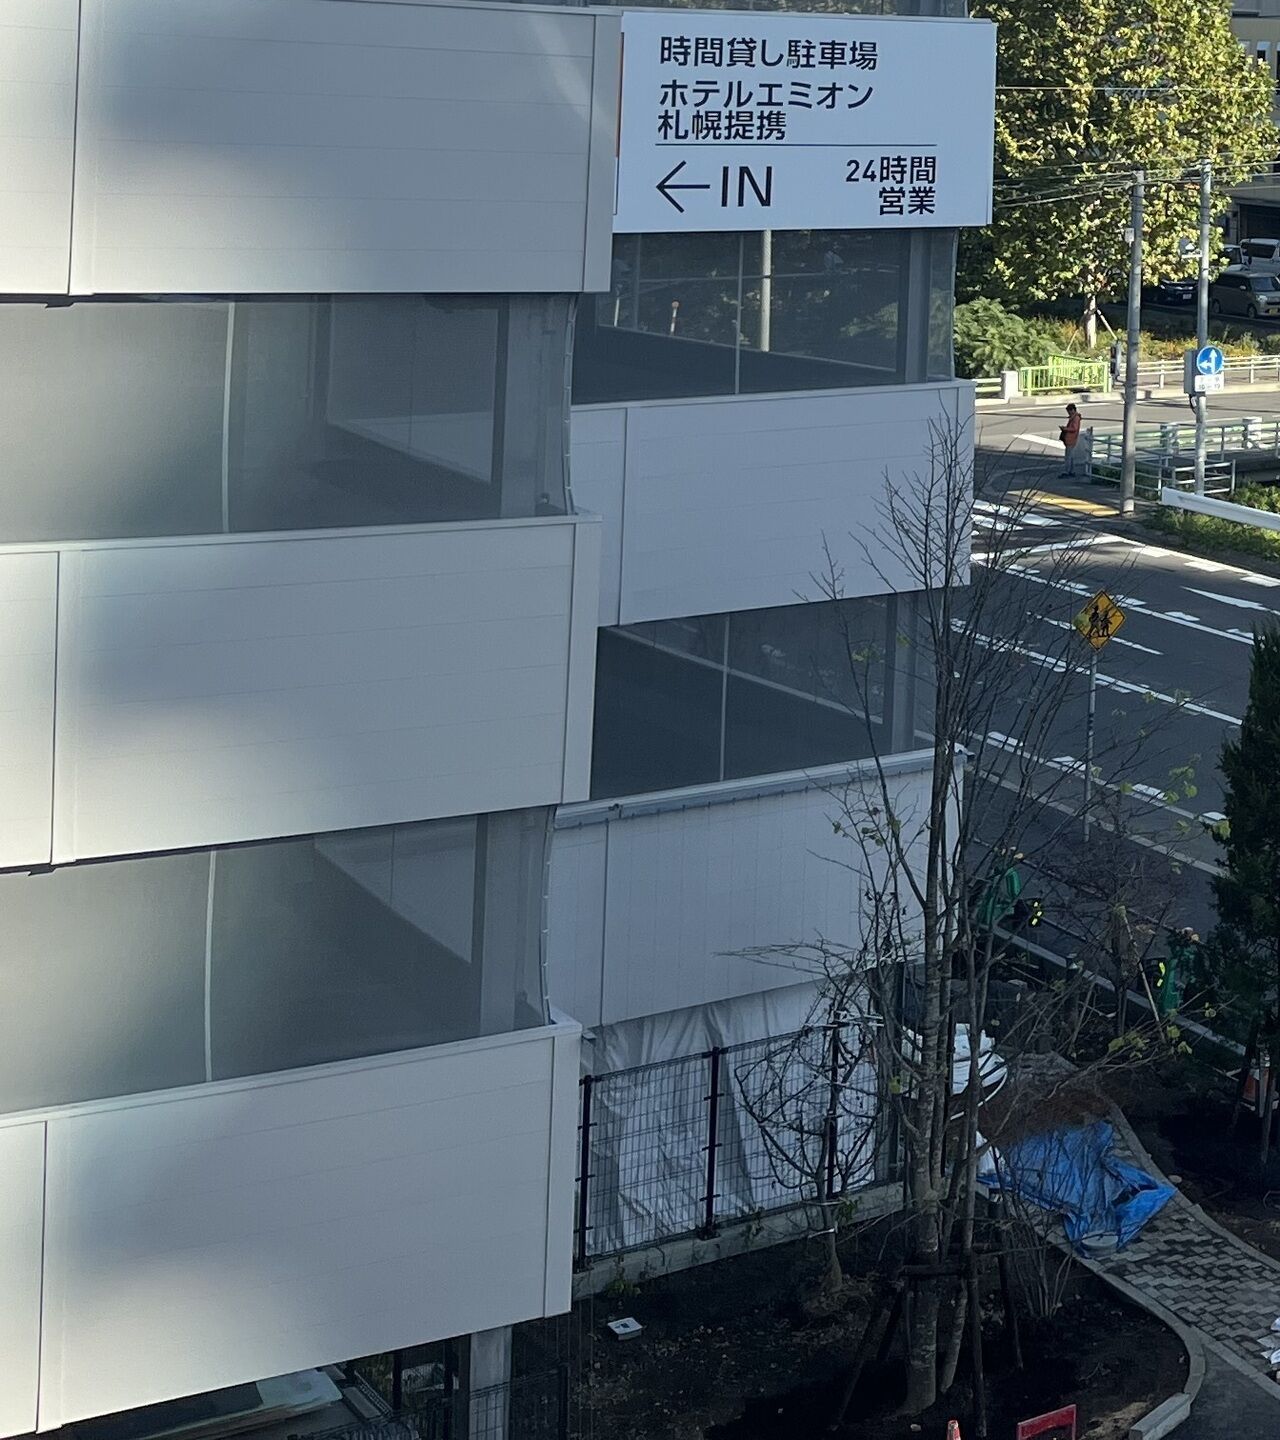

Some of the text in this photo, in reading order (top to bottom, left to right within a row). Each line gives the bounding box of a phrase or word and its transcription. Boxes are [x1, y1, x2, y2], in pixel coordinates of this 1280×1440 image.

[659, 36, 878, 71] 時間貸し駐車場
[659, 80, 874, 109] ホテルエミオン
[657, 110, 787, 141] 札幌提携
[845, 155, 937, 185] 24時間
[721, 165, 772, 208] IN
[878, 186, 936, 216] 営業
